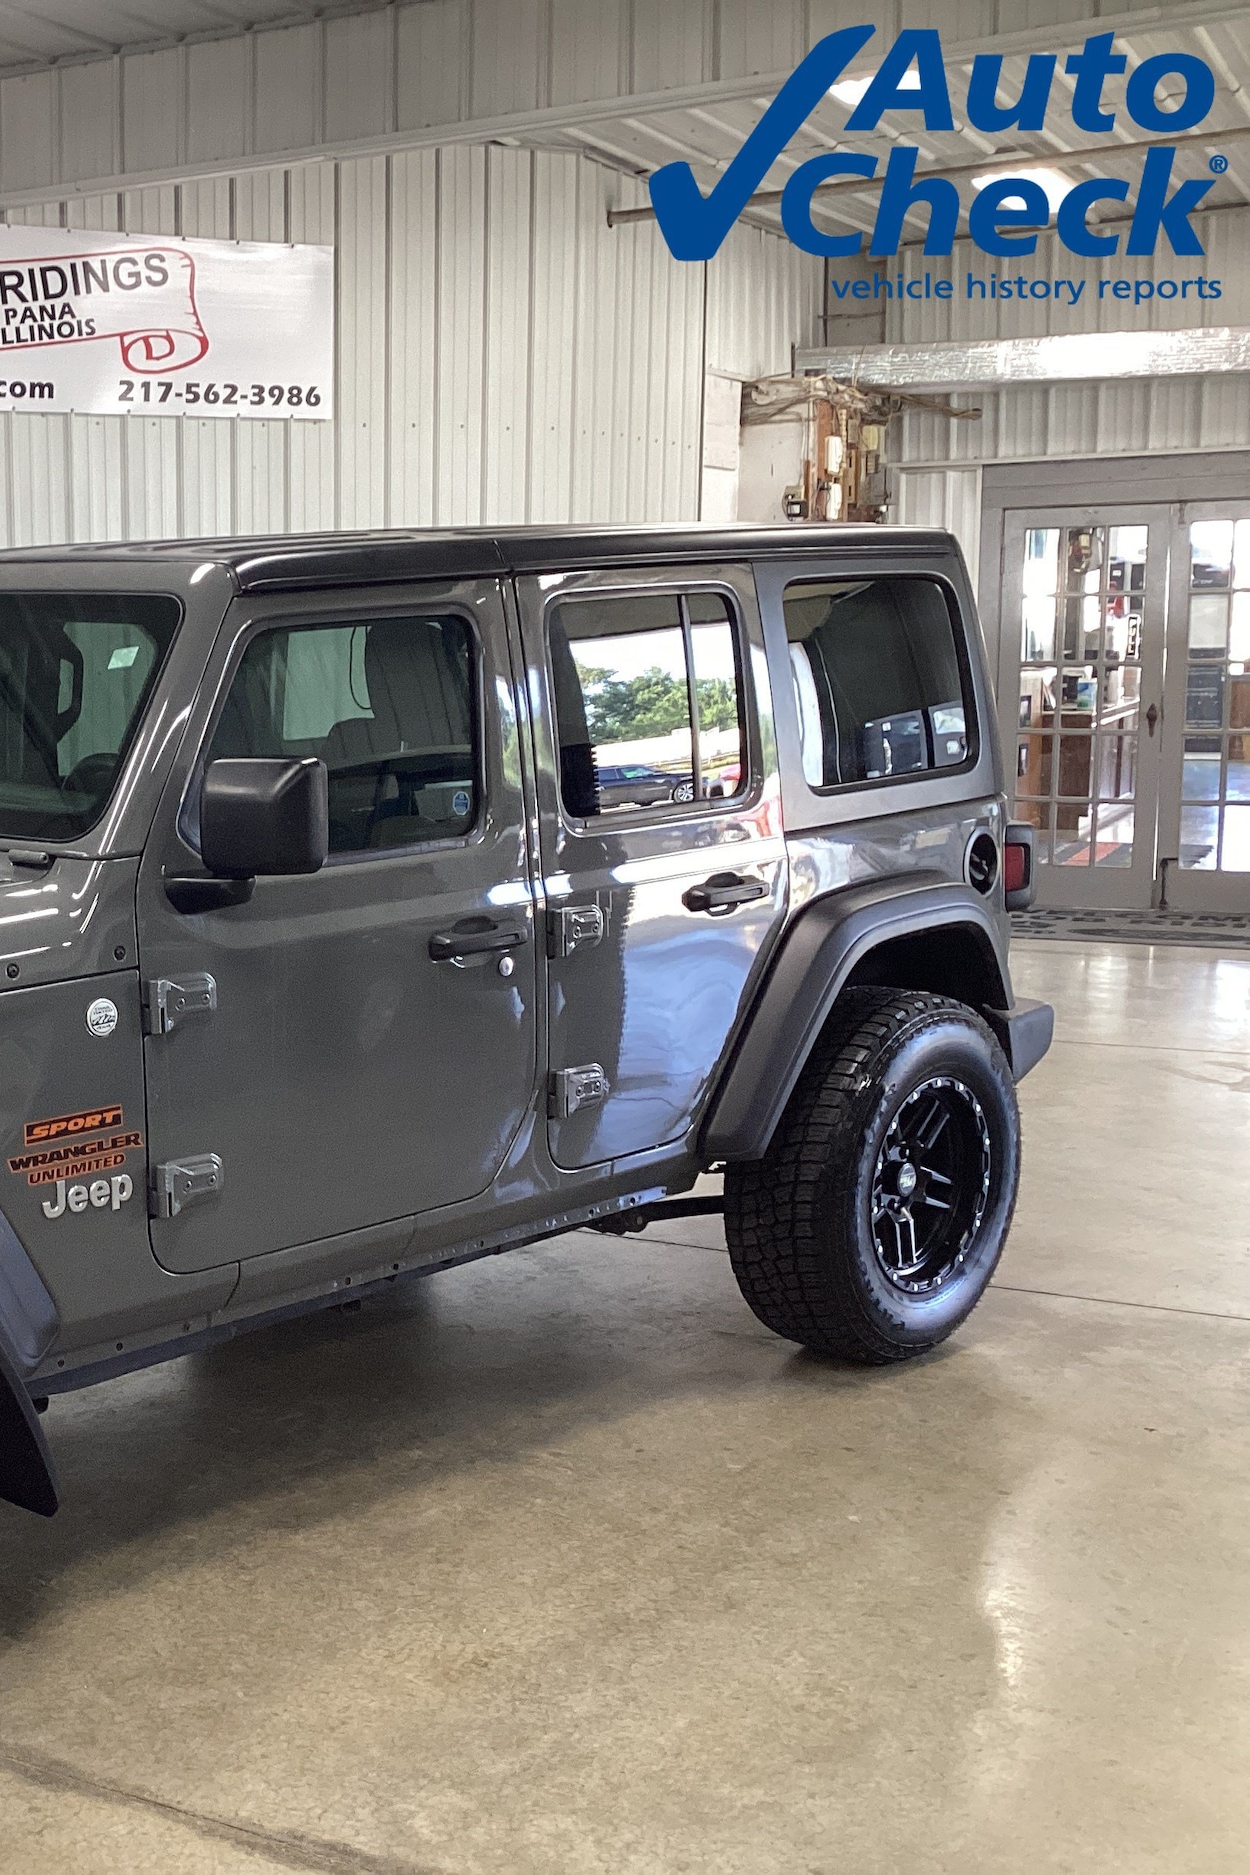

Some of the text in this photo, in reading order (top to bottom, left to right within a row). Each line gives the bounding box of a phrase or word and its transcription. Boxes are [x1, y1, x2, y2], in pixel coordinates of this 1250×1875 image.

[0, 253, 170, 305] RIDINGS
[4, 302, 77, 325] PANA
[118, 380, 322, 407] 217-562-3986
[33, 1111, 120, 1137] SPORT
[8, 1132, 143, 1173] WRANGLER
[29, 1153, 126, 1185] UNLIMITED
[42, 1174, 133, 1219] Jeep
